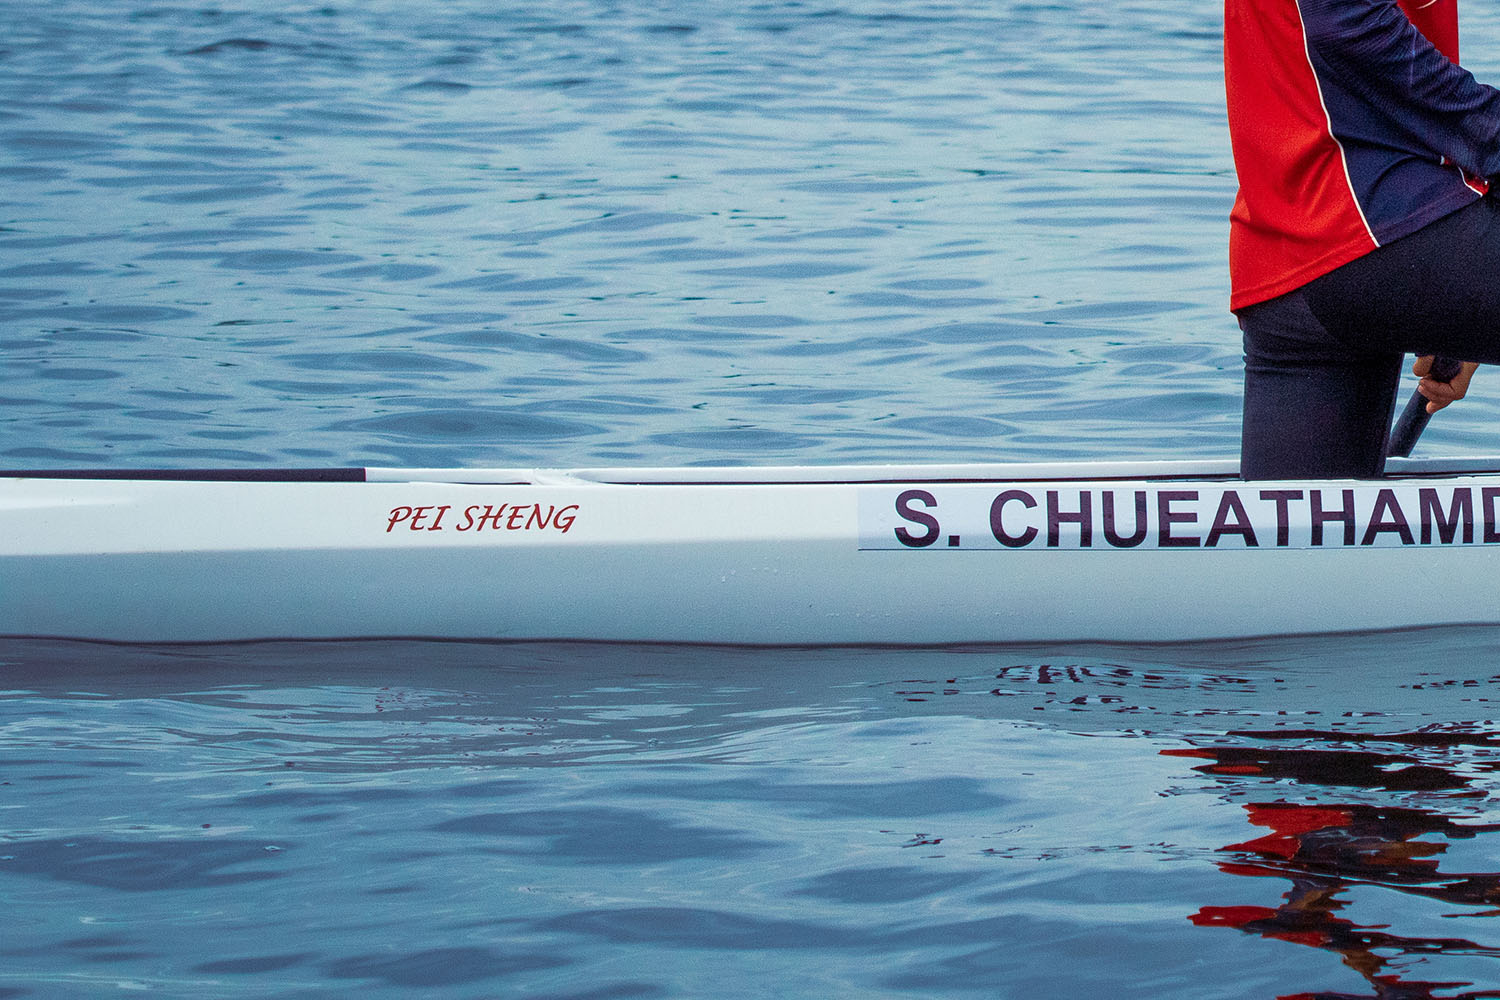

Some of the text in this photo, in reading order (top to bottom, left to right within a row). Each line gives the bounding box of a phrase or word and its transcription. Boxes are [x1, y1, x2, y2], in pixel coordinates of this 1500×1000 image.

[386, 503, 580, 533] PEI SHENG
[894, 489, 960, 548] S.
